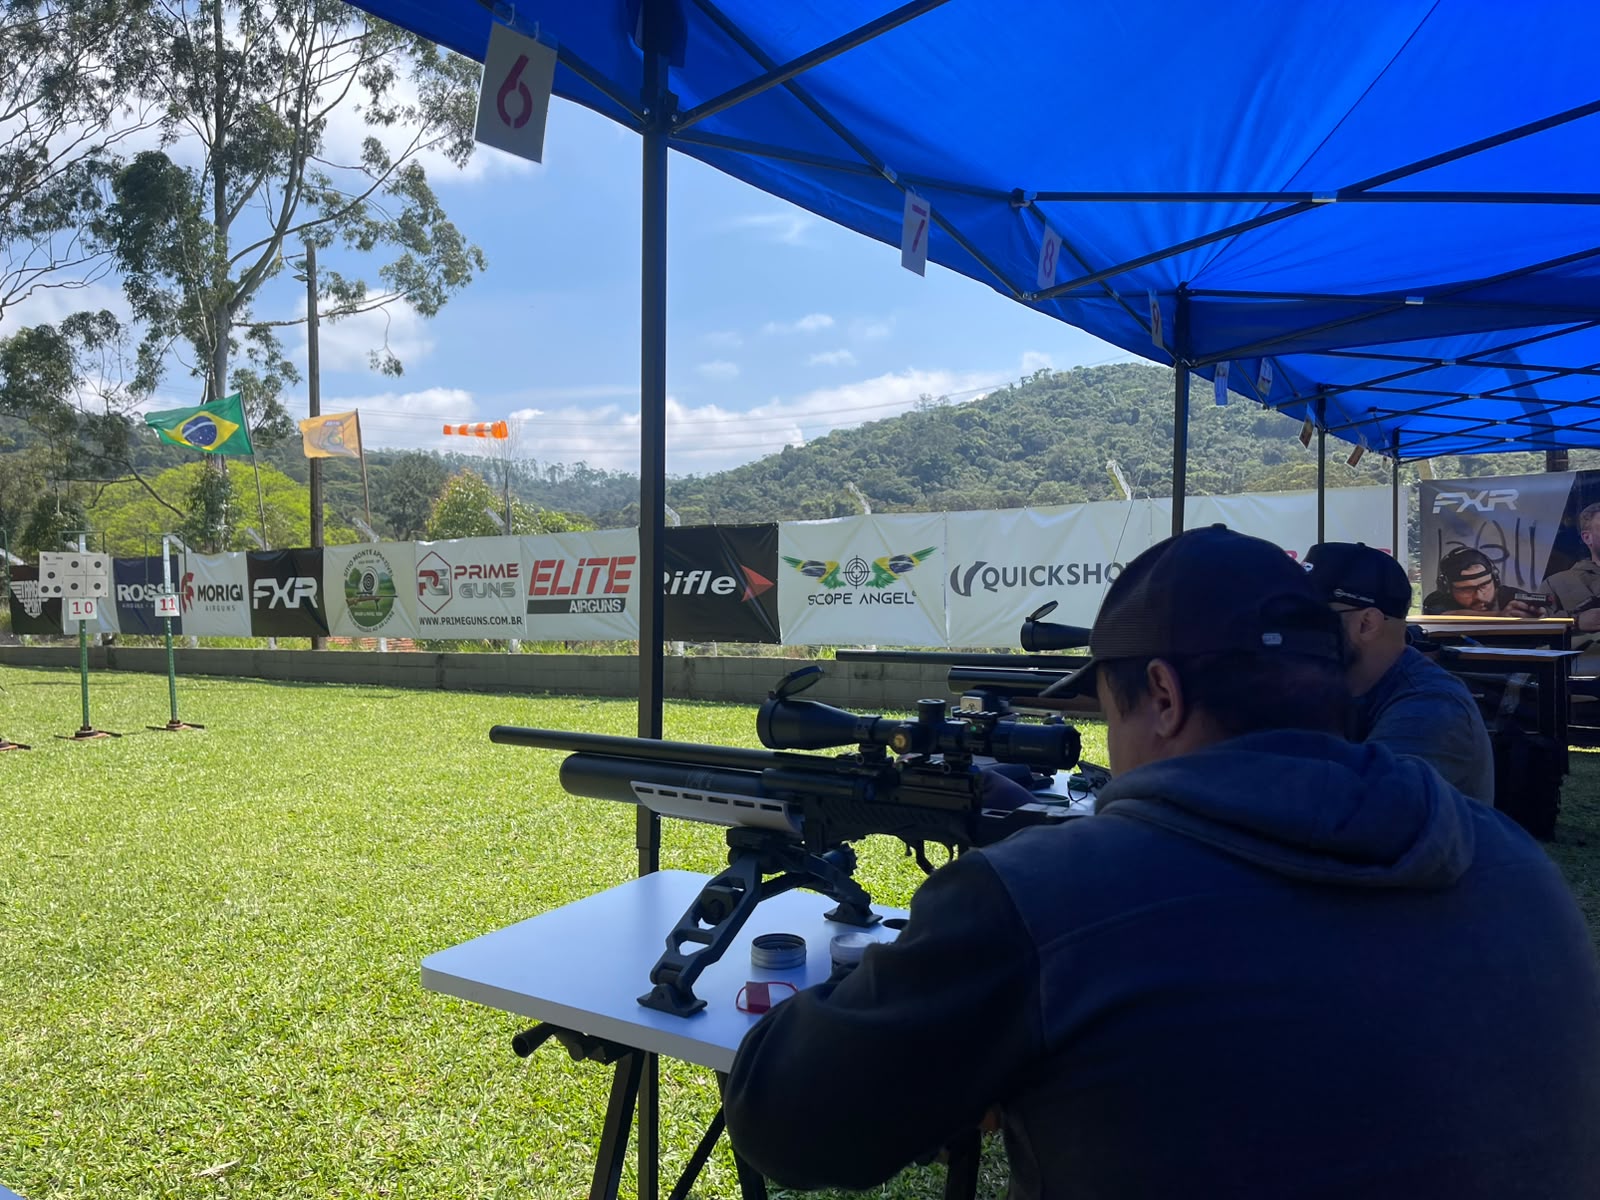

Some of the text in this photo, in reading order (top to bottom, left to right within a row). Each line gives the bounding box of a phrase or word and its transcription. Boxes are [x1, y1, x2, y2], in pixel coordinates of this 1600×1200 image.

[495, 54, 533, 130] 6
[910, 203, 927, 253] 7
[1042, 237, 1055, 279] 8
[1432, 488, 1520, 514] FXR
[453, 563, 520, 580] PRIME
[981, 561, 1130, 592] QUICKSHO
[197, 583, 244, 602] MORIGI
[252, 576, 319, 609] FXR
[458, 581, 516, 599] GUNS
[807, 592, 853, 606] SCOPE
[72, 601, 94, 615] 10
[159, 597, 176, 611] 11
[569, 598, 622, 613] AIRGUNS
[418, 616, 523, 626] WWW.PRIMEGUNS.COM.BR
